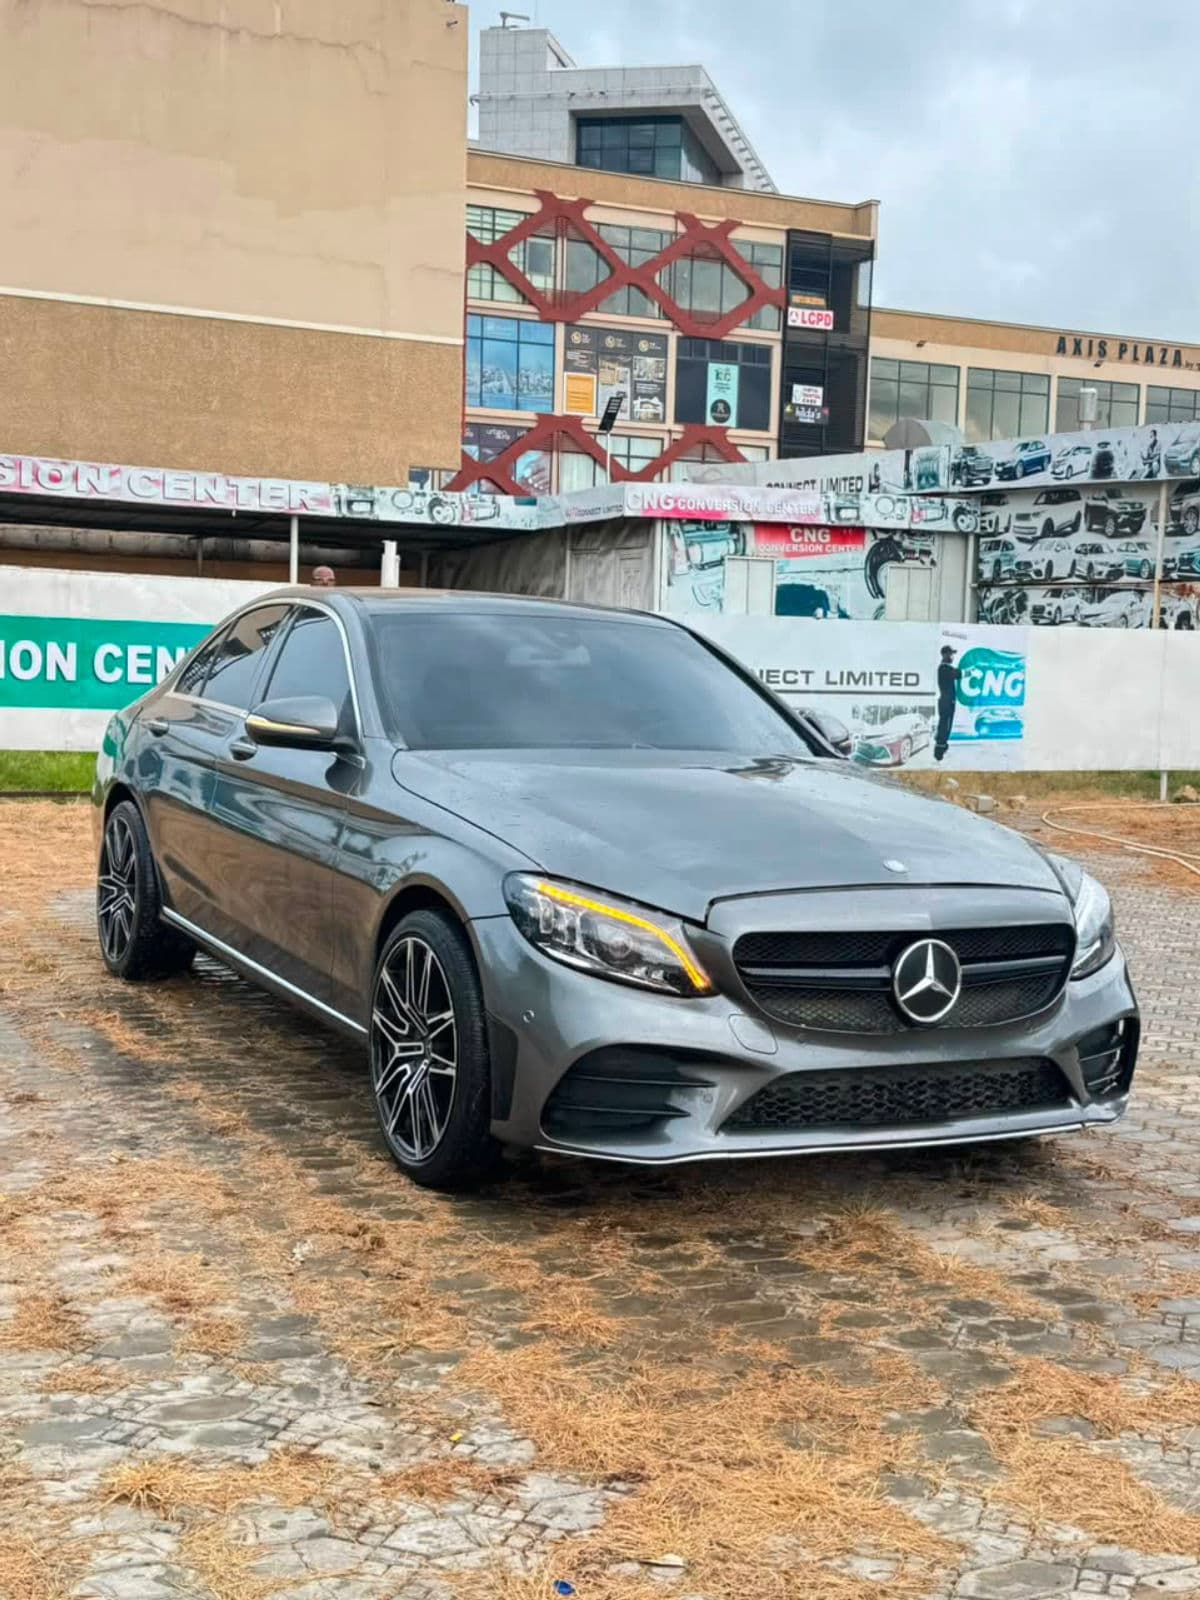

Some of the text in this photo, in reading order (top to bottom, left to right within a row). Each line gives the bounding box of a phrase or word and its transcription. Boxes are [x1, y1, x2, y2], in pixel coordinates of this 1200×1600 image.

[801, 311, 832, 327] LCPD
[1056, 336, 1107, 358] AXIS
[1118, 343, 1182, 367] PLAZA
[127, 468, 325, 512] CENTER
[820, 475, 863, 494] LIMITED
[627, 489, 817, 517] CNG CONVERSION CENTER
[790, 527, 831, 543] CNG
[759, 543, 864, 553] CONVERSION CENTER
[94, 643, 194, 683] CEN
[825, 670, 920, 687] LIMITED
[960, 669, 1025, 698] CNG
